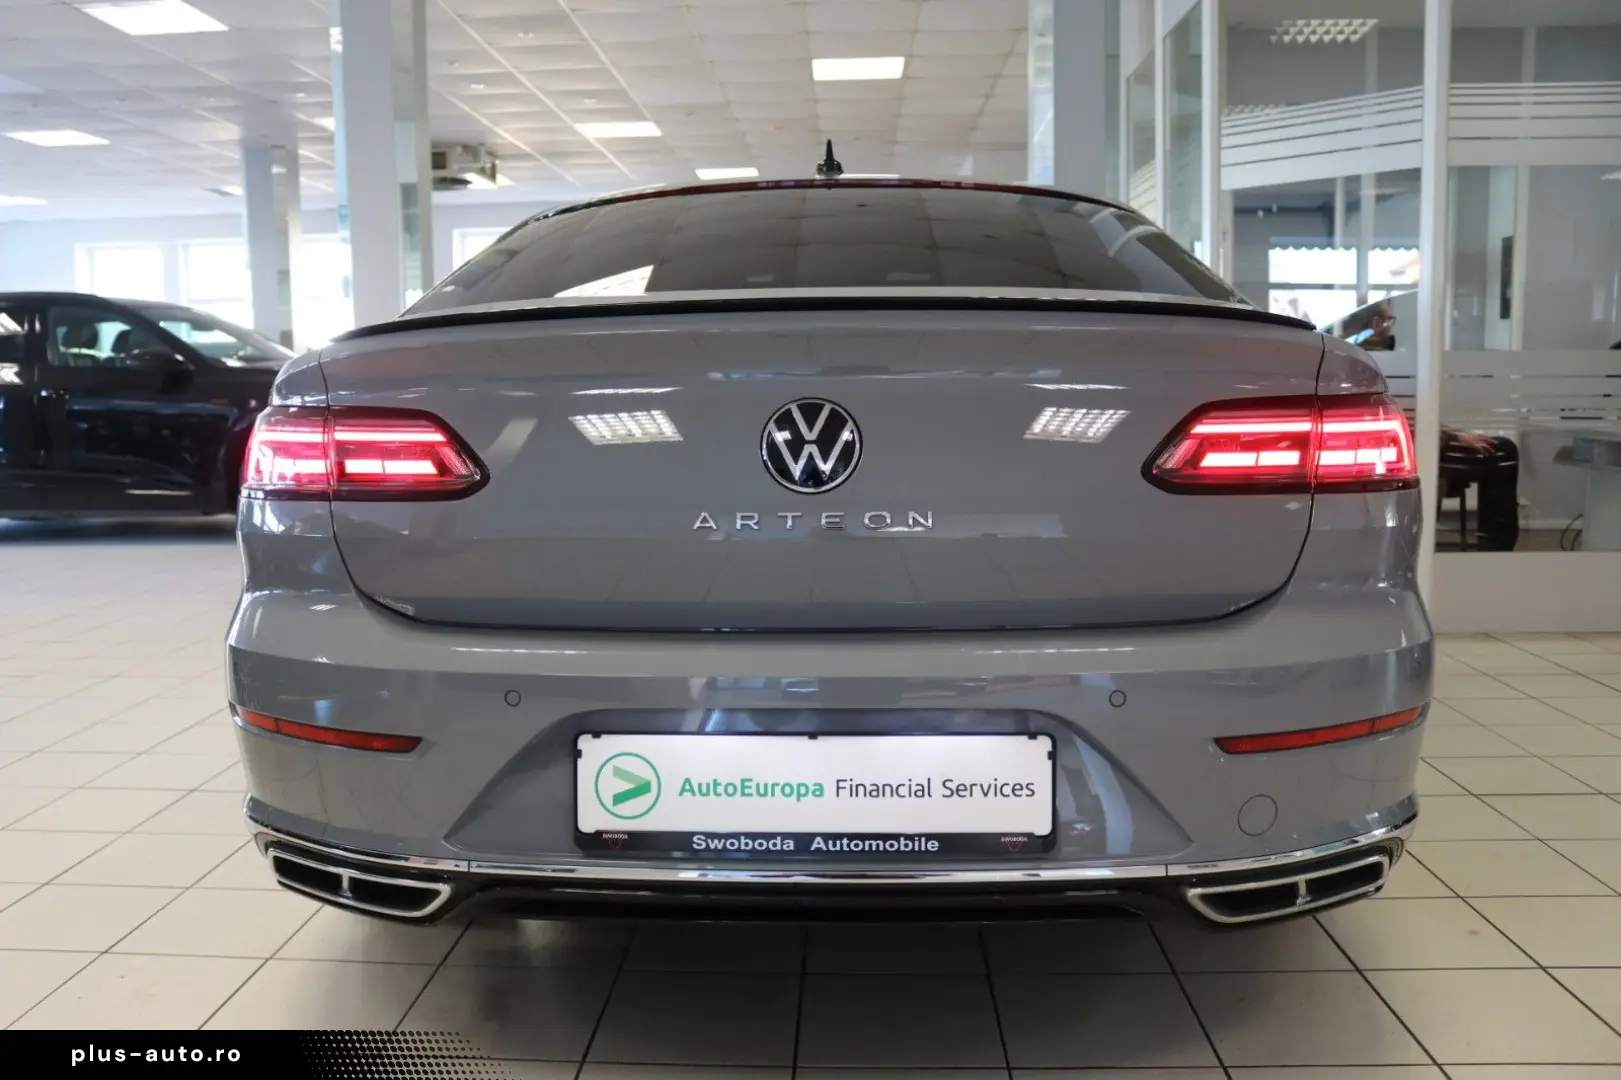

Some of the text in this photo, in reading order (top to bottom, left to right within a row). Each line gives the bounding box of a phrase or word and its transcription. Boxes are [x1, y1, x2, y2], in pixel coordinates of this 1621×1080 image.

[764, 399, 859, 489] VW
[692, 510, 933, 531] ARTEON
[678, 776, 1036, 802] AutoEuropa Financial Services
[692, 834, 940, 853] Swoboda Automobile
